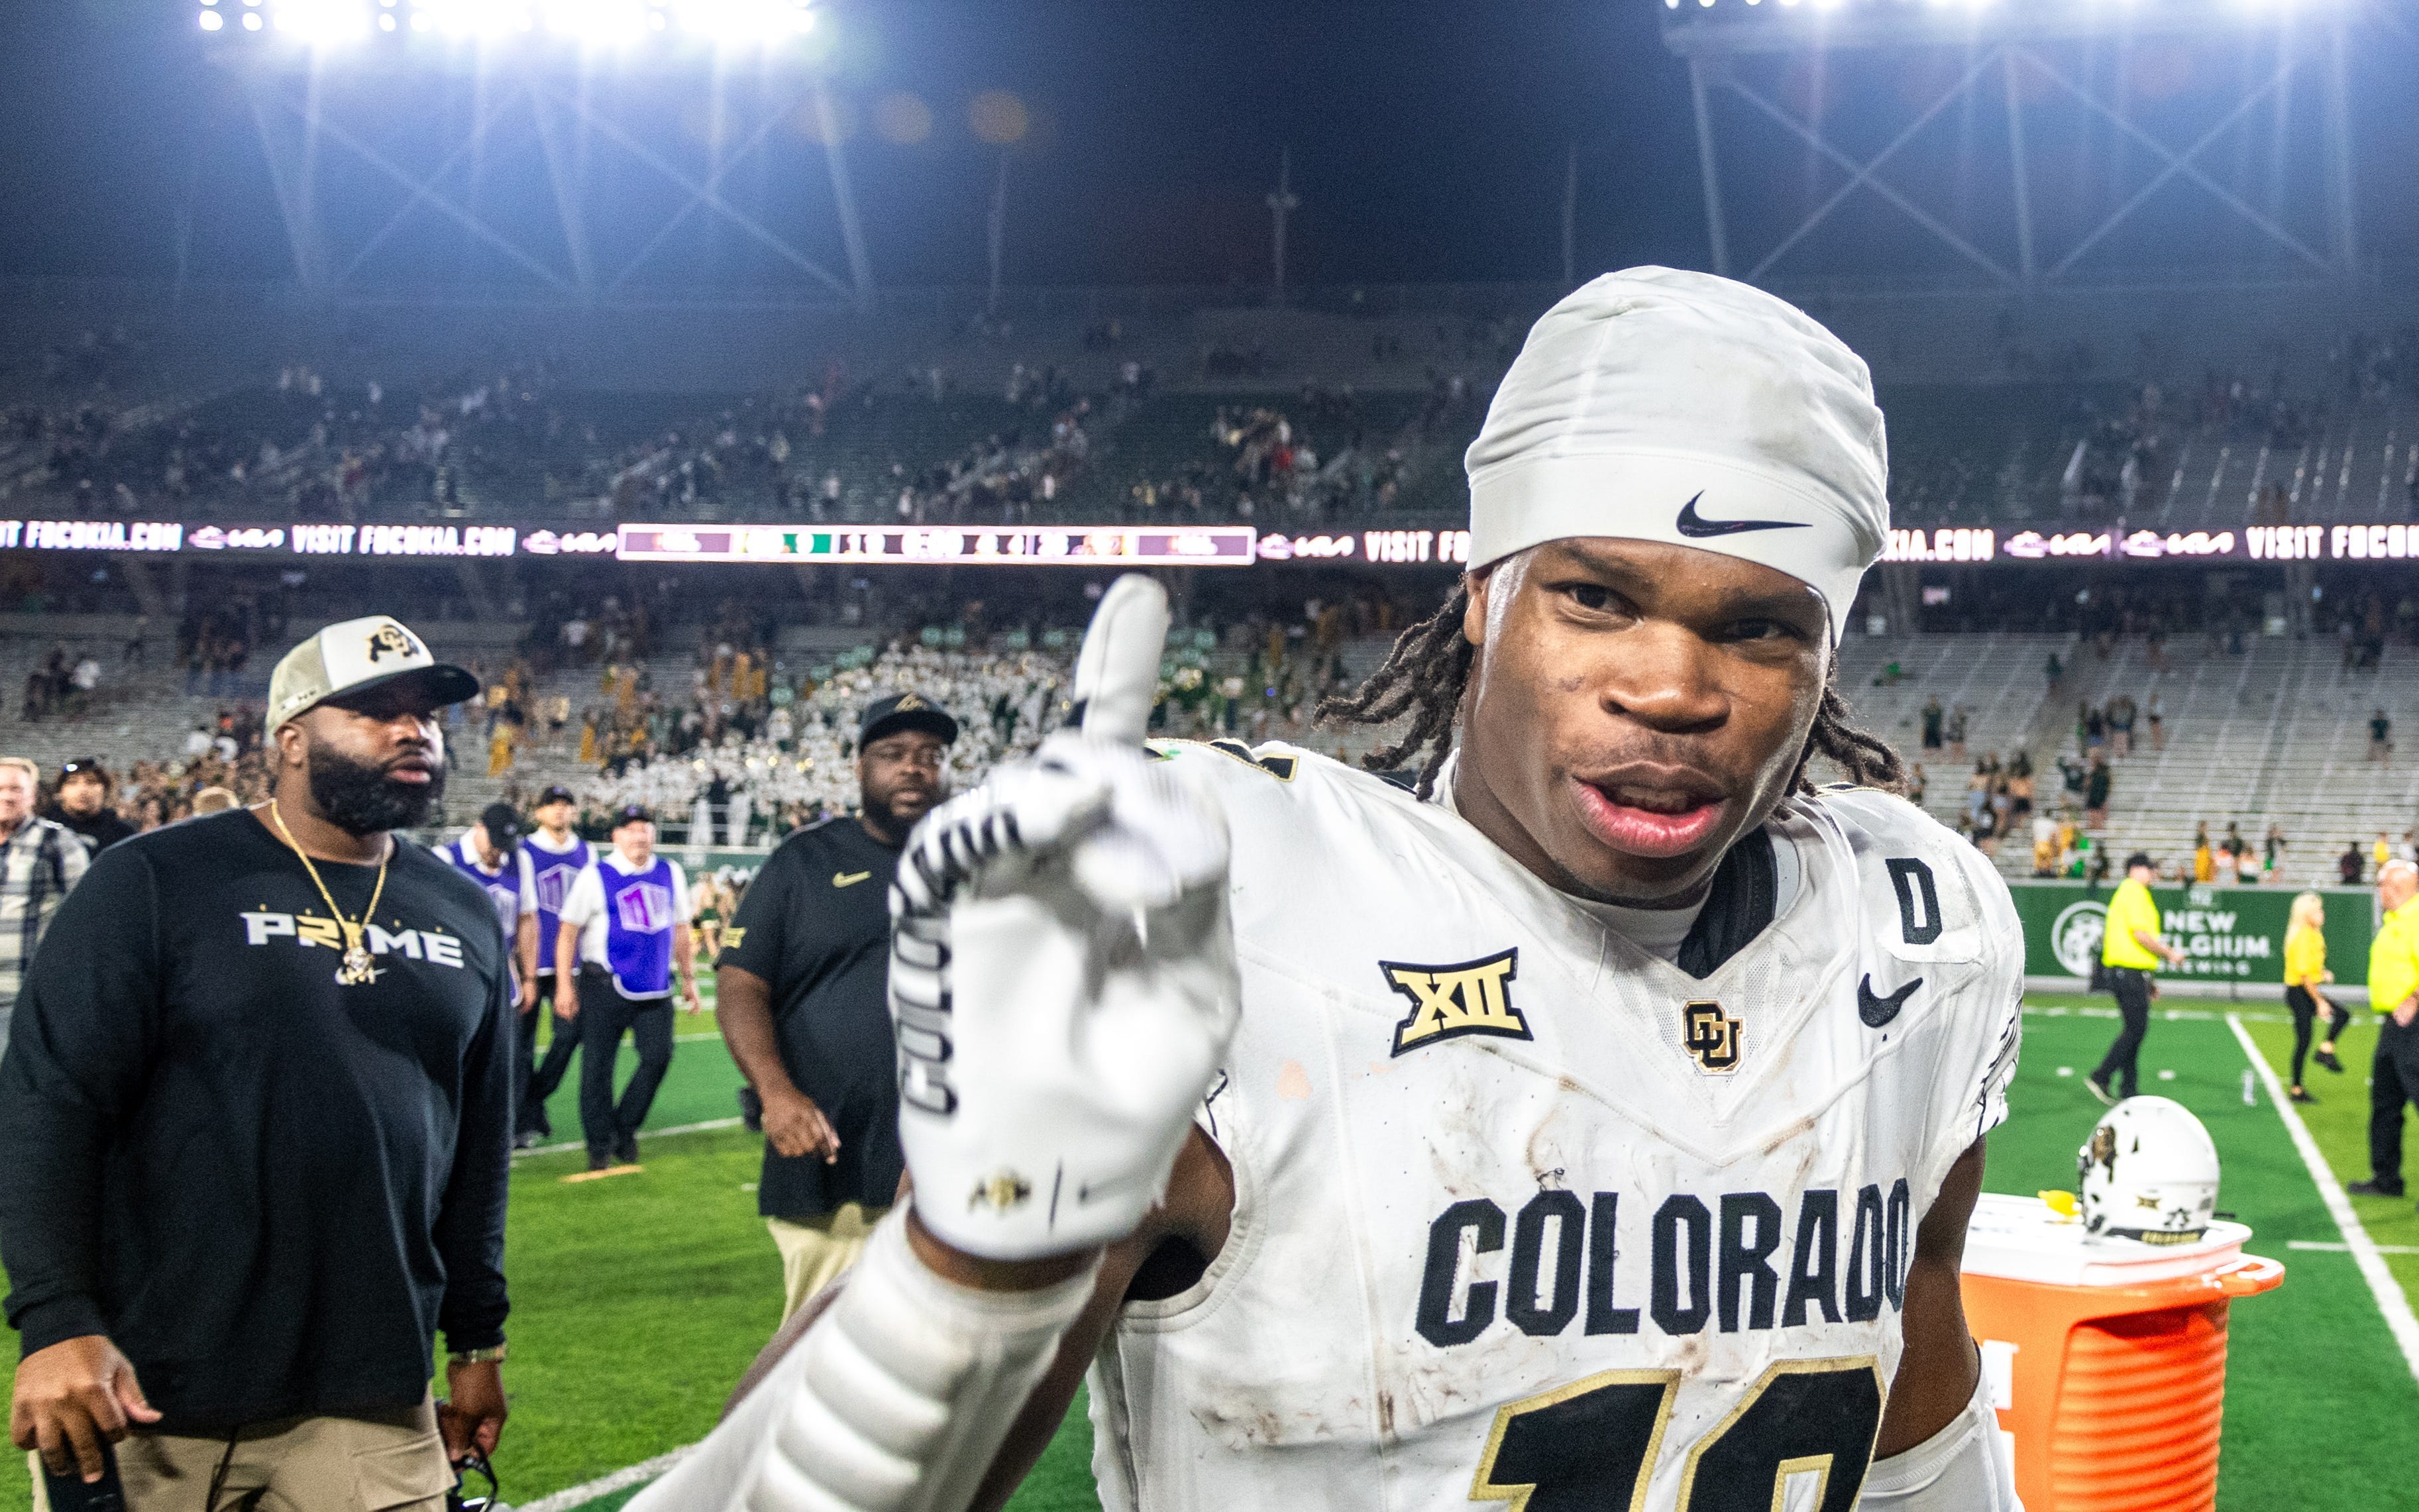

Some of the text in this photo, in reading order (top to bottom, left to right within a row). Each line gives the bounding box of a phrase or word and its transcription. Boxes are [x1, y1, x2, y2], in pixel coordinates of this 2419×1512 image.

[292, 525, 356, 553] VISIT
[1364, 531, 1434, 563] VISIT
[2245, 526, 2324, 559] VISIT
[2163, 910, 2237, 933] NEW
[1391, 957, 1525, 1046] XII
[1680, 999, 1743, 1073] CU
[1415, 1177, 1910, 1348] COLORADO
